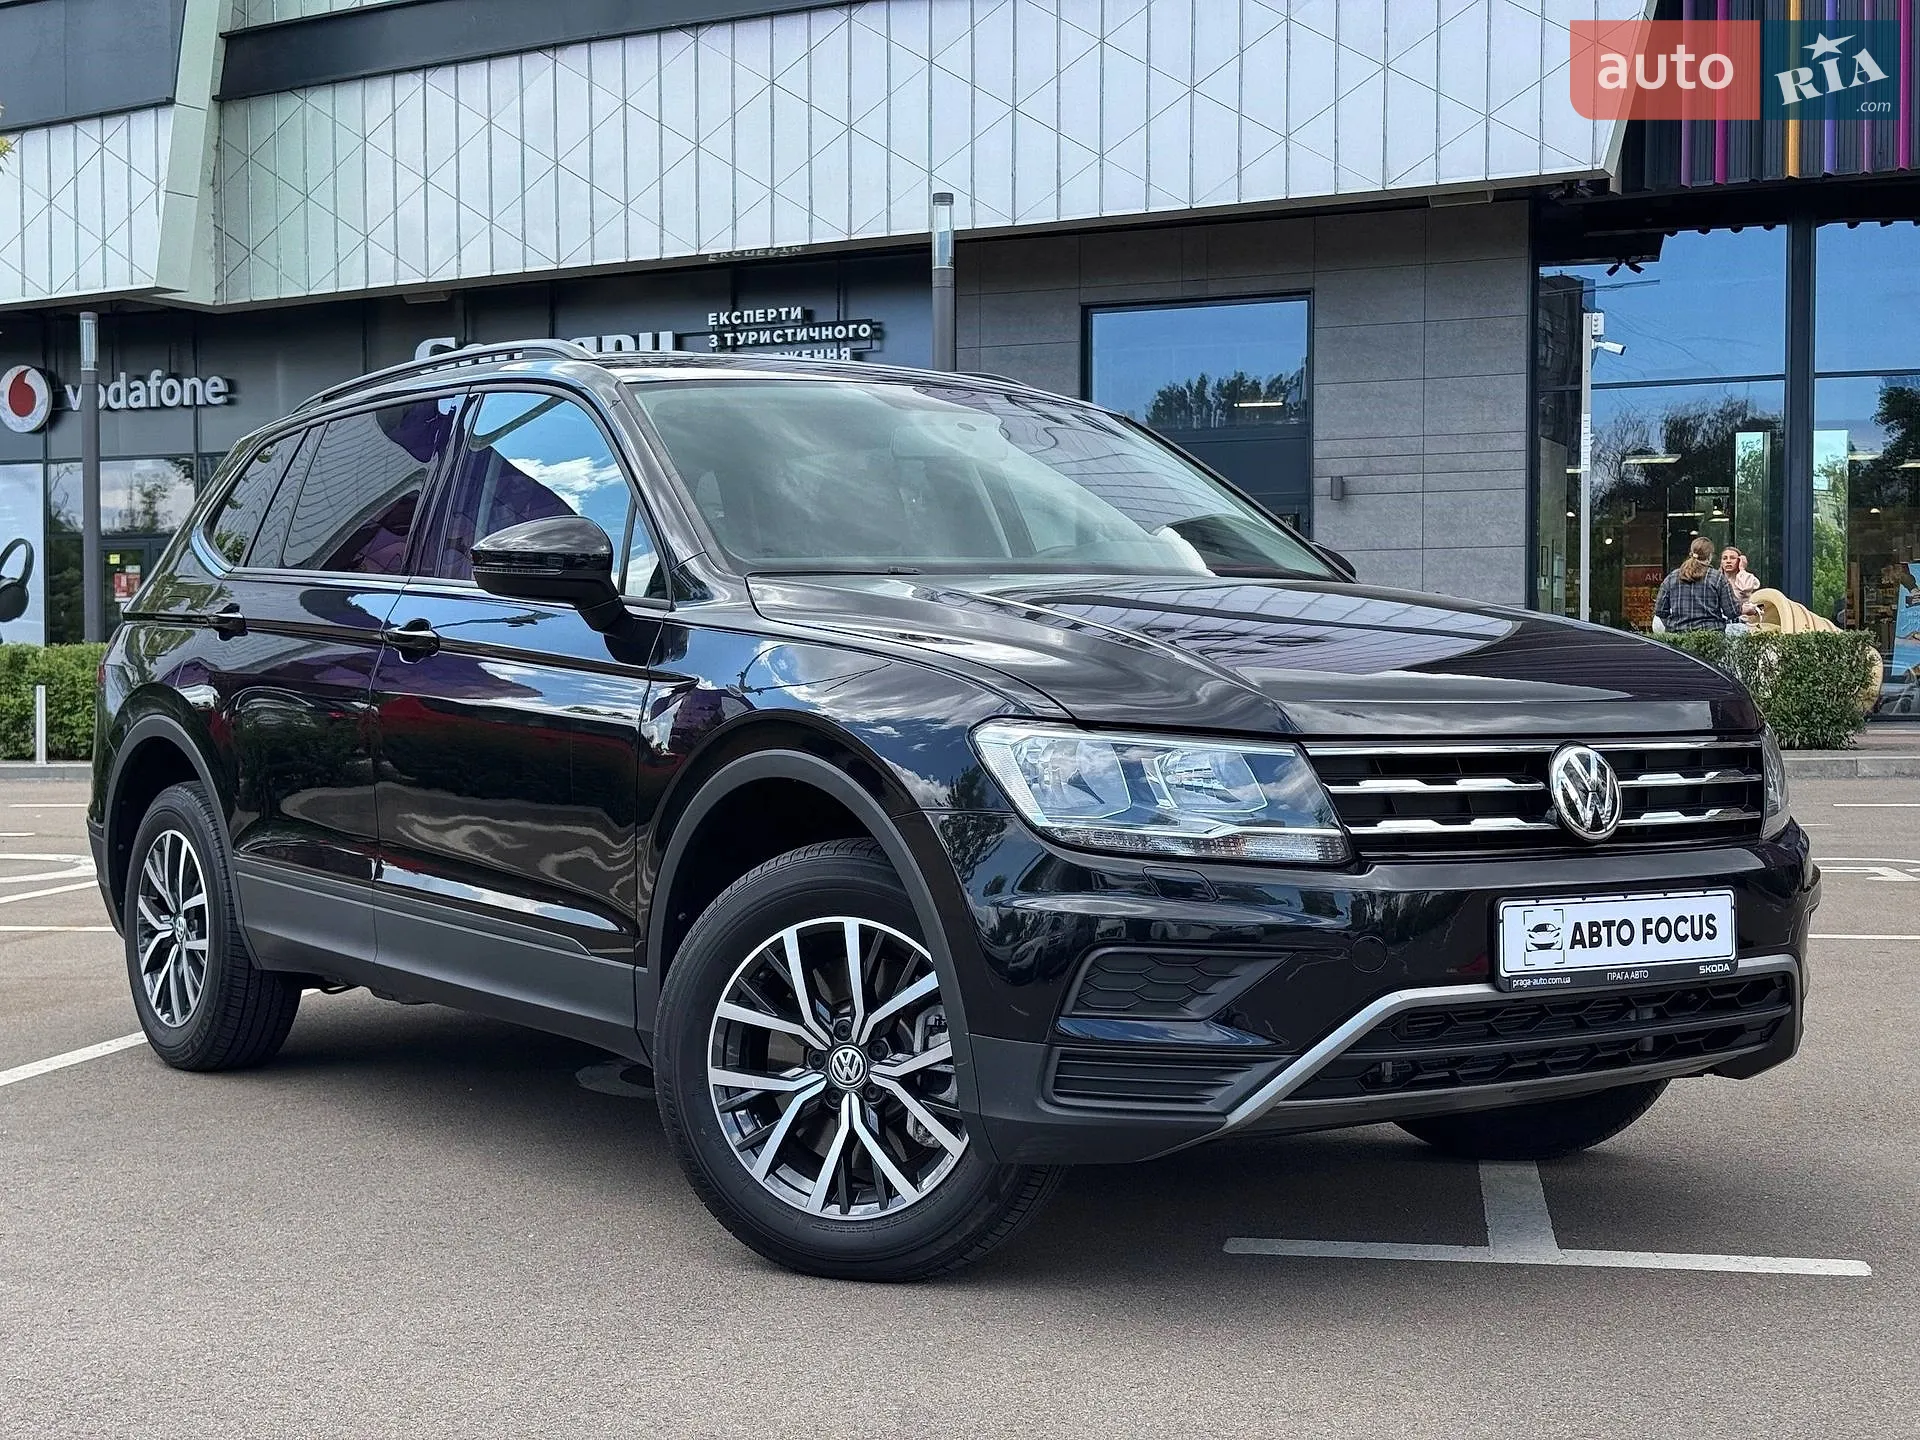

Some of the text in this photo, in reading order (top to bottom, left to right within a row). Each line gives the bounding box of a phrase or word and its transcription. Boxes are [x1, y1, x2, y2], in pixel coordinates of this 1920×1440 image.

[708, 306, 802, 326] ЕКСПЕРТИ
[724, 323, 872, 346] ТУРИСТИЧНОГО
[1642, 913, 1718, 945] FOCUS
[1607, 972, 1629, 981] ПРАГА
[1699, 963, 1730, 974] SKODA
[1512, 976, 1571, 988] praga-auto.com.ua
